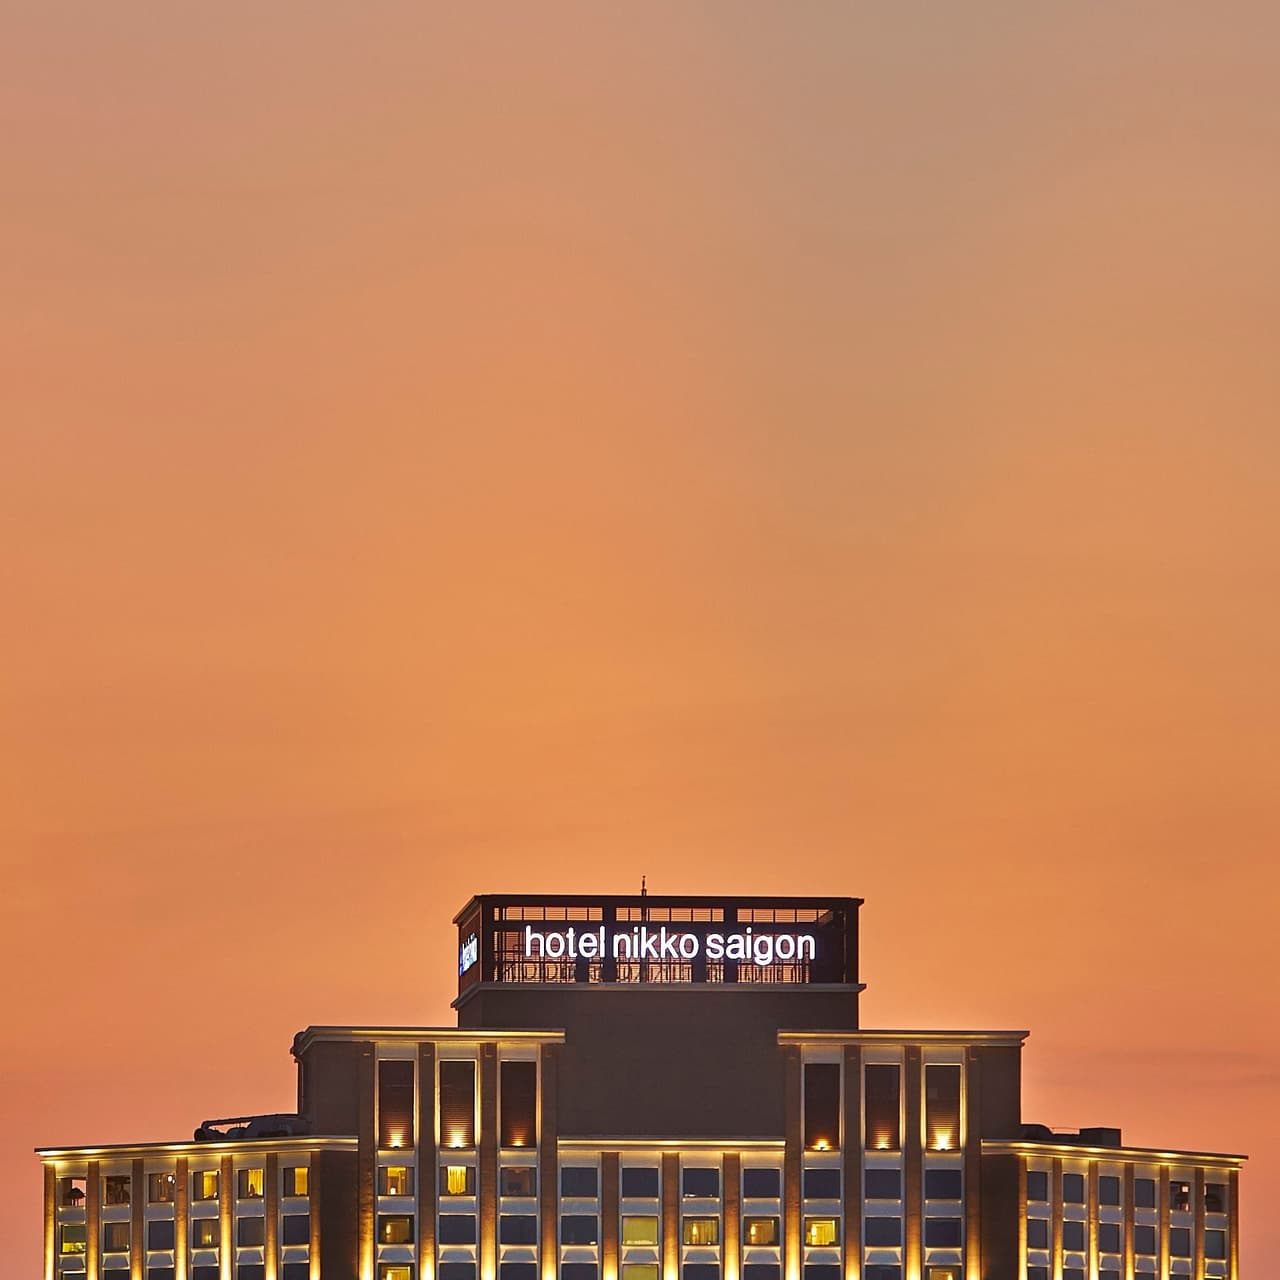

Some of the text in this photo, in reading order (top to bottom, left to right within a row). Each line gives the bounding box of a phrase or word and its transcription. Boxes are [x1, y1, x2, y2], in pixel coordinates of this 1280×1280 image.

[525, 925, 816, 966] hotel nikko saigon
